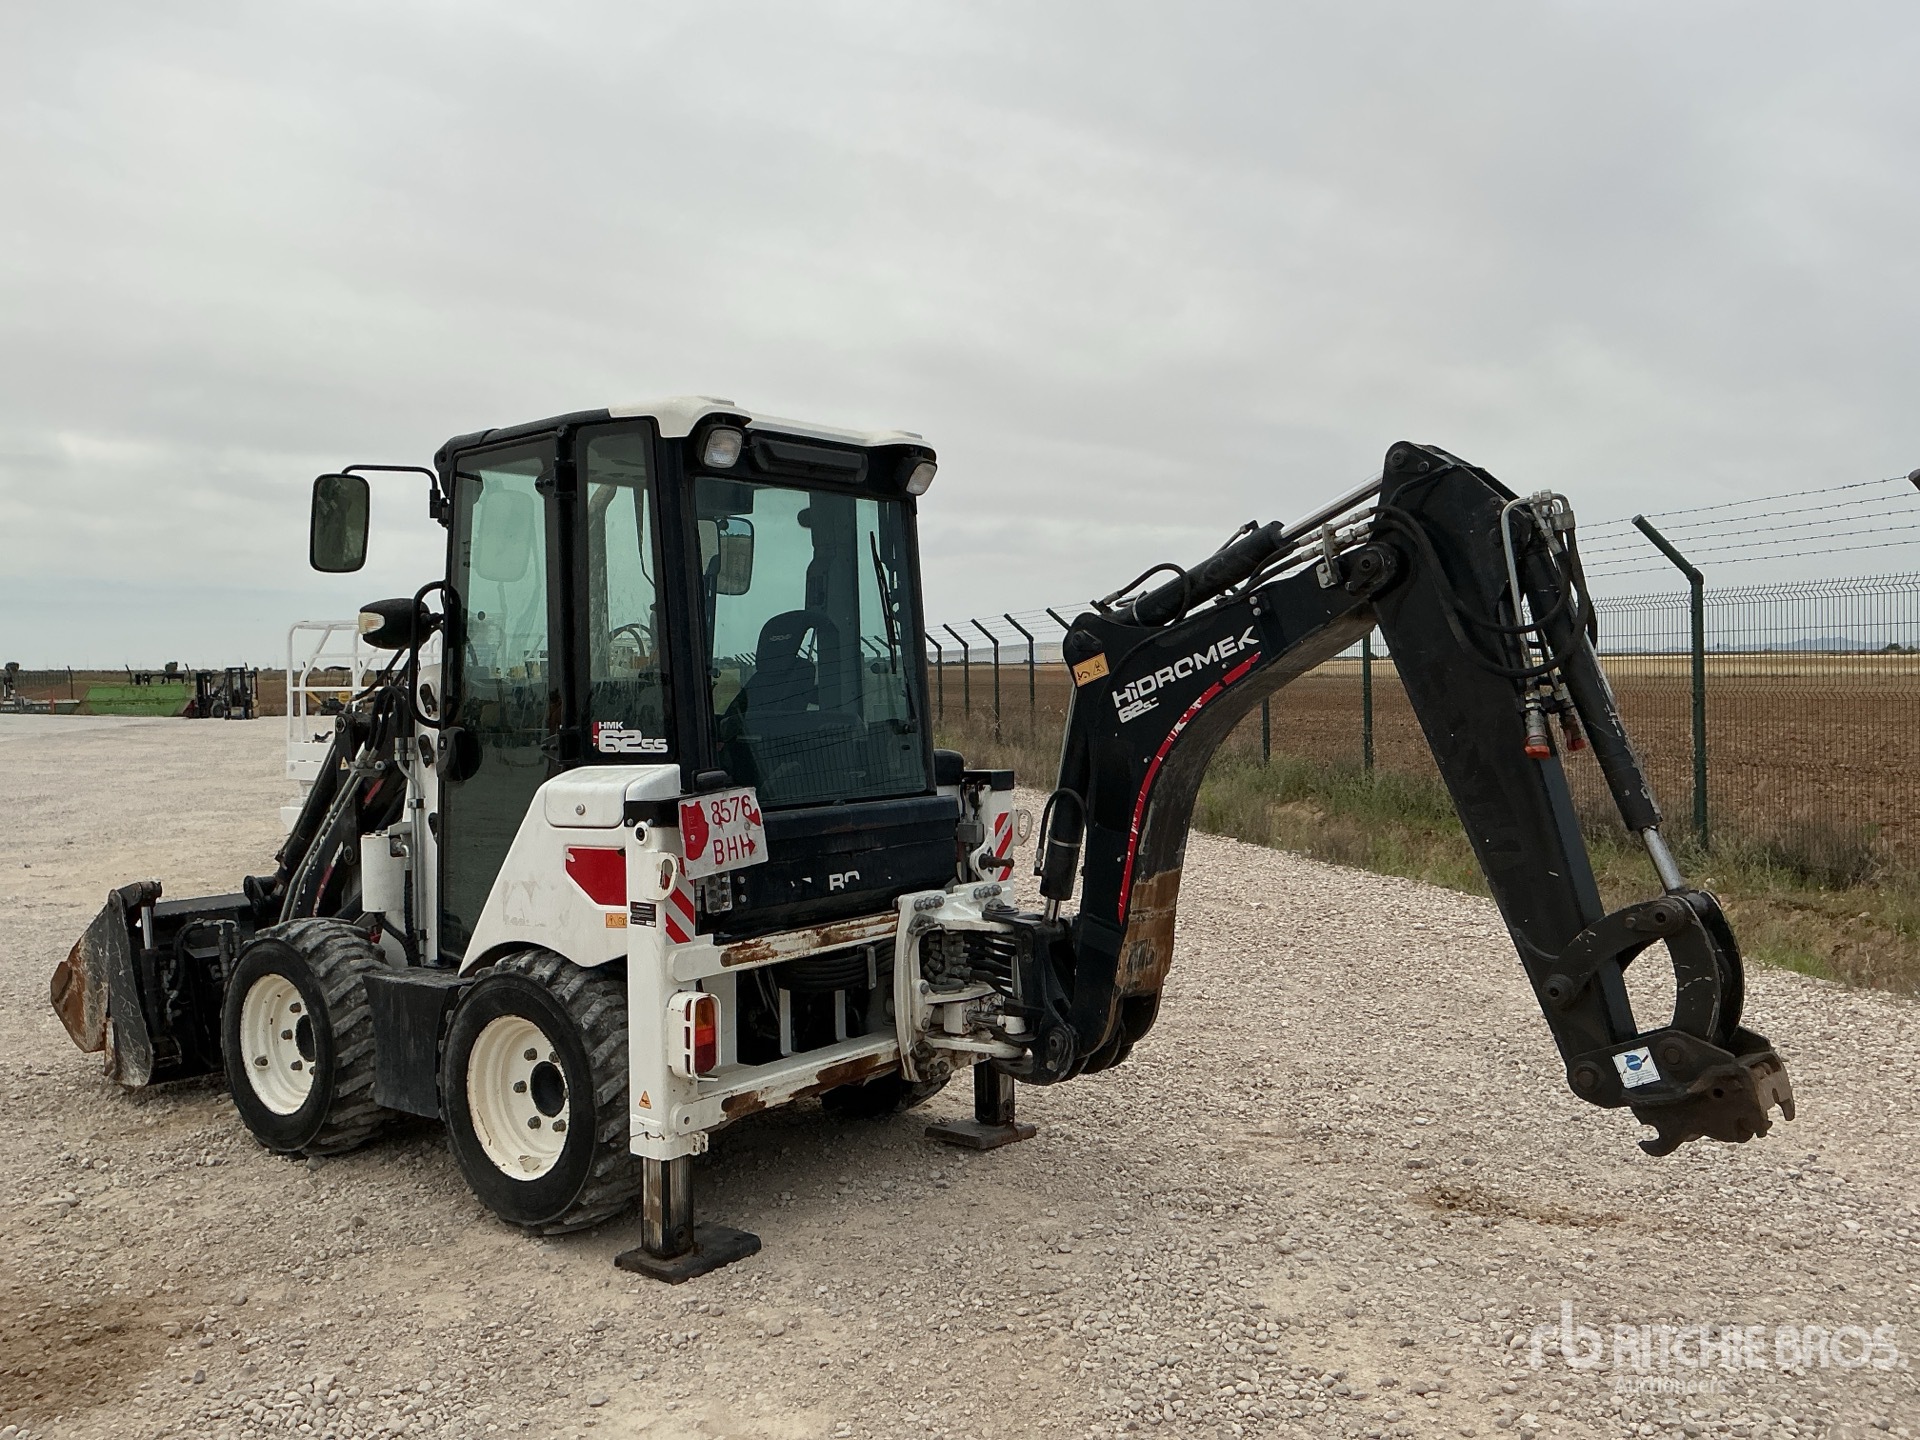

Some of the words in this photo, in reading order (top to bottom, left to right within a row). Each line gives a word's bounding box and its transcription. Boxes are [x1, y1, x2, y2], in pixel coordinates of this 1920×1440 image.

[598, 721, 624, 730] HMK
[598, 729, 668, 753] 62SS
[711, 794, 753, 826] 8576
[713, 832, 756, 865] BHH
